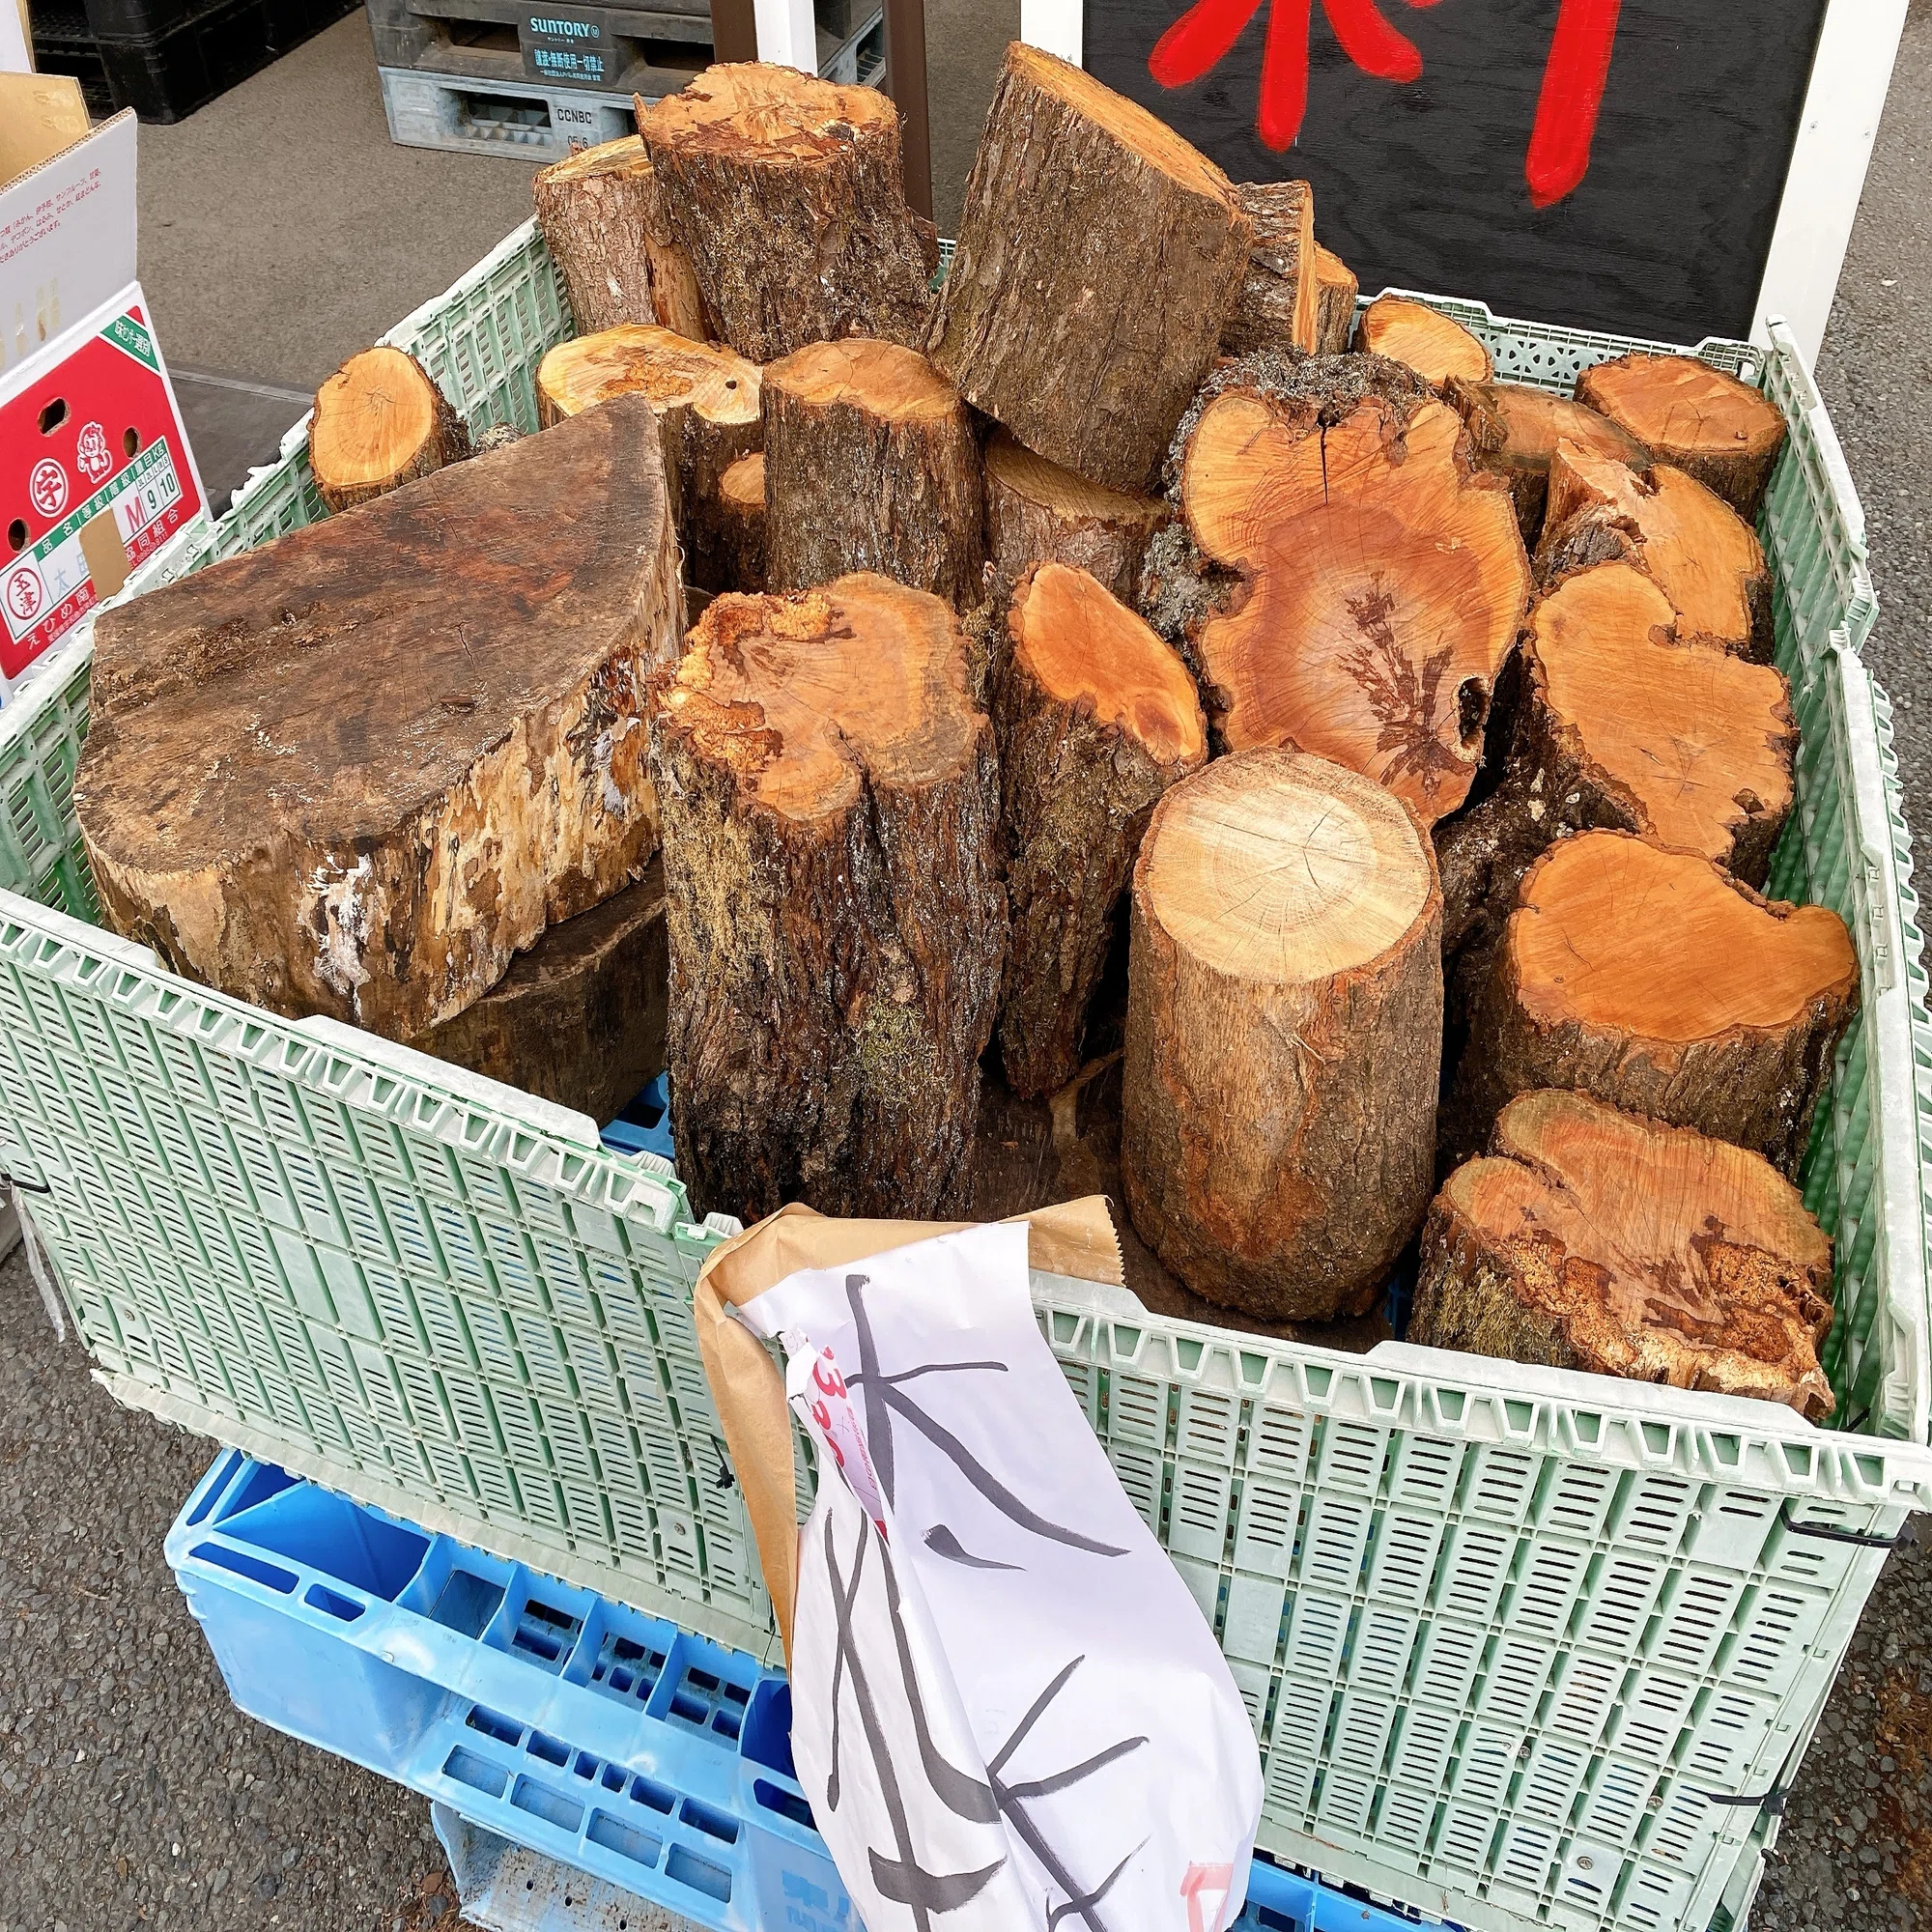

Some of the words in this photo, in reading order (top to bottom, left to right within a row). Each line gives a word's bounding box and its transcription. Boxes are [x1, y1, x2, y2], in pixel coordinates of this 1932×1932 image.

[529, 17, 589, 38] SUNTORY
[556, 108, 592, 125] CCNBC
[125, 496, 146, 533] M
[147, 490, 157, 510] 9
[159, 472, 176, 497] 10
[14, 574, 37, 615] 玉津
